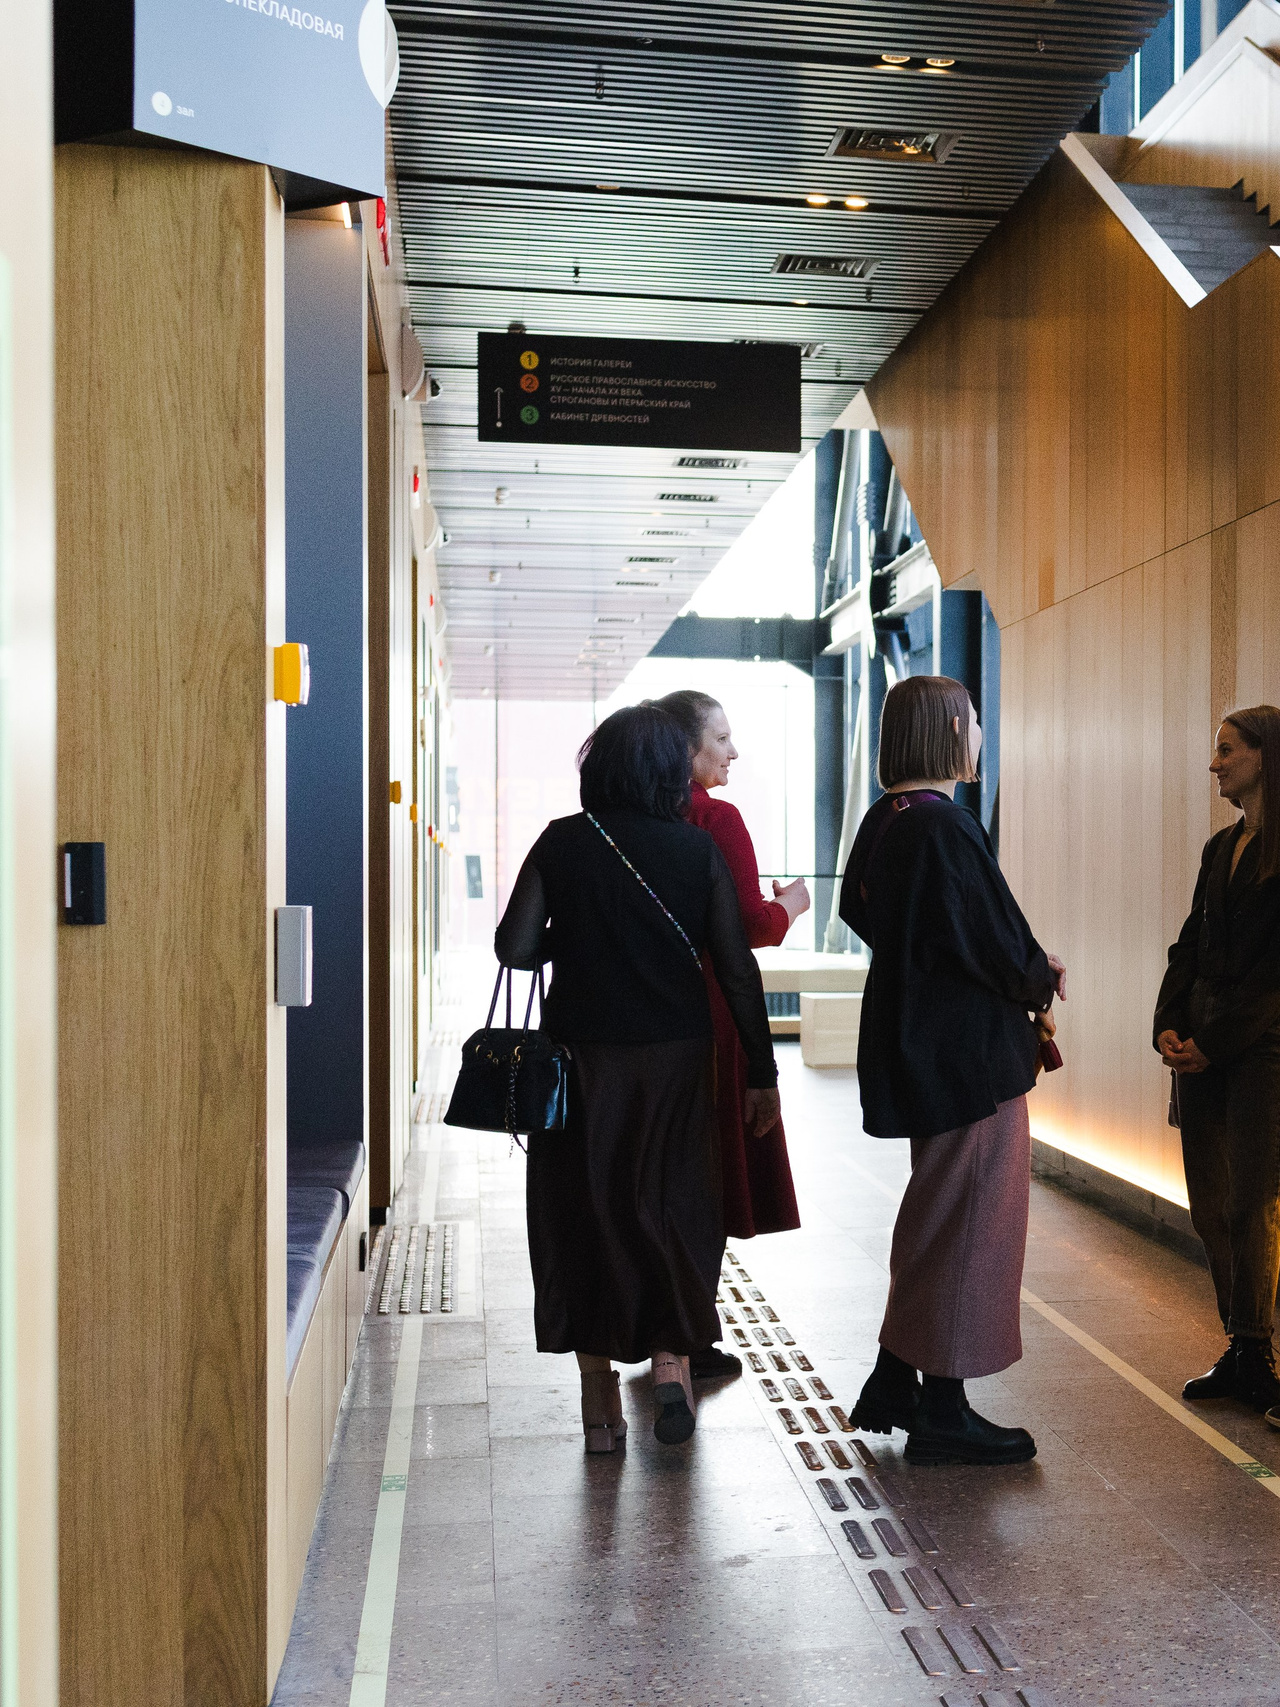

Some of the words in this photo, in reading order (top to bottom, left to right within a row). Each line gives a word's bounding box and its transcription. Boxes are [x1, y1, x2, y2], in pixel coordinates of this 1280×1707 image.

[176, 105, 195, 118] зал
[550, 357, 592, 367] ИСТОРИЯ
[593, 359, 633, 369] ГАЛЕРЕИ
[525, 376, 534, 389] 2
[550, 374, 591, 384] РУССКОЕ
[592, 376, 662, 387] ПРАВОСЛАВНОЕ
[664, 380, 717, 389] ИСКУССТВО
[571, 386, 606, 395] НАЧАЛА
[550, 395, 609, 406] СТРОГАНОВЫ
[610, 398, 618, 406] И
[619, 398, 668, 408] ПЕРМСКИЙ
[669, 399, 691, 409] КРАЙ
[525, 408, 534, 421] 3
[550, 412, 589, 421] КАБИНЕТ
[591, 412, 650, 424] ДРЕВНОСТЕЙ
